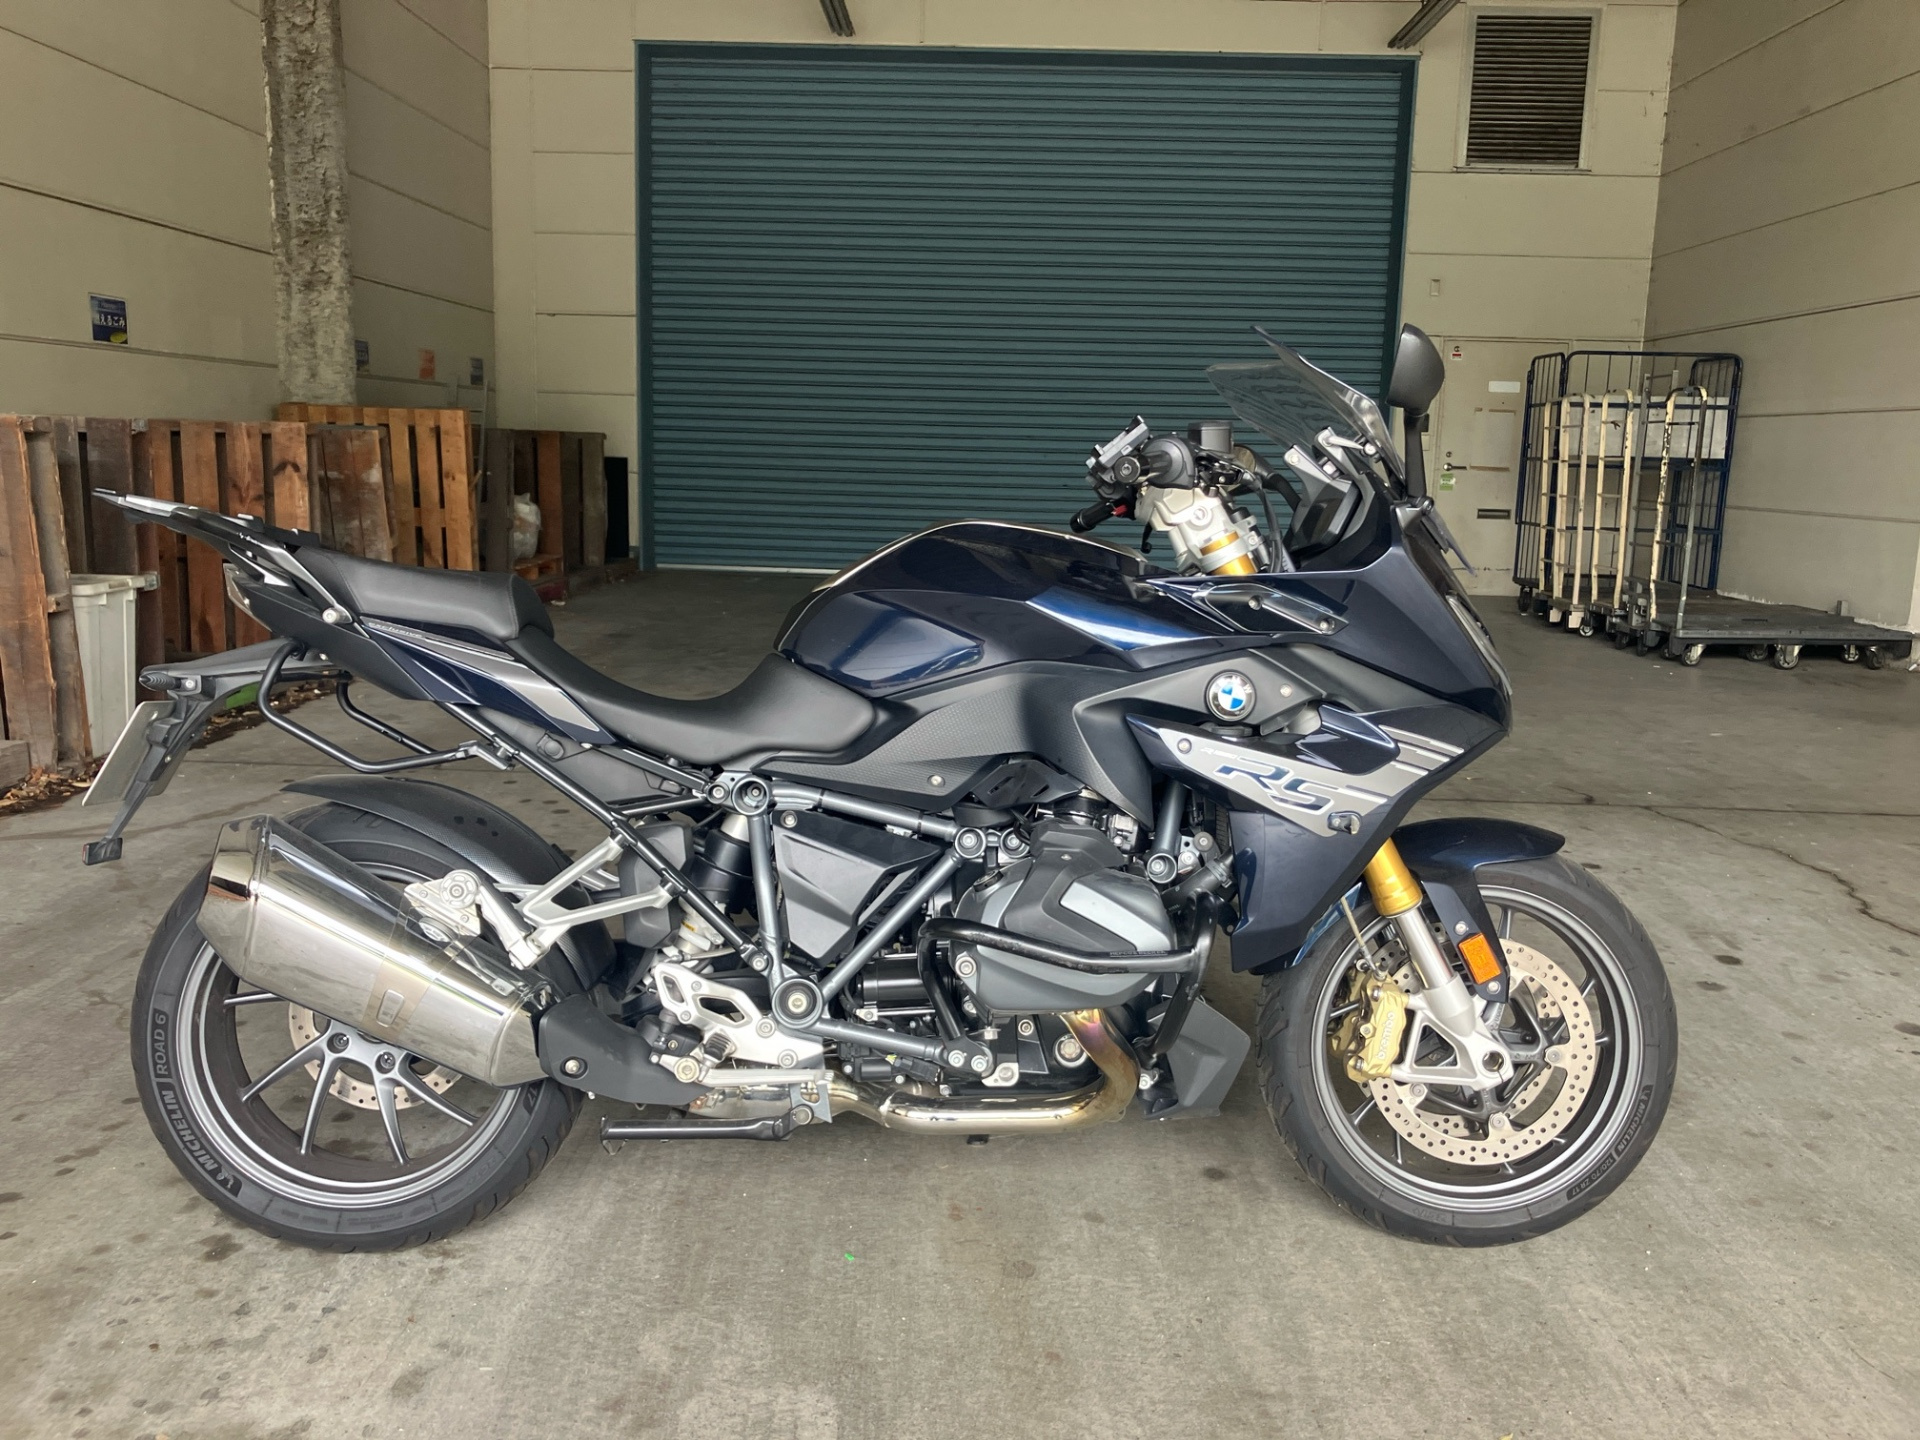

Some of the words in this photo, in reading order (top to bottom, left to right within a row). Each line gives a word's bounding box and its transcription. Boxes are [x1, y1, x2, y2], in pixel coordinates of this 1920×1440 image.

[93, 313, 125, 328] えるごみ
[368, 622, 423, 638] exclusive
[1213, 757, 1336, 815] RS
[154, 1013, 167, 1025] 6
[1376, 1011, 1397, 1061] brembo
[153, 1028, 169, 1075] ROAD
[161, 1089, 219, 1172] MICHELIN
[1617, 1102, 1646, 1153] MICHELIN
[1580, 1179, 1590, 1189] ZR
[1591, 1158, 1614, 1180] 120/70
